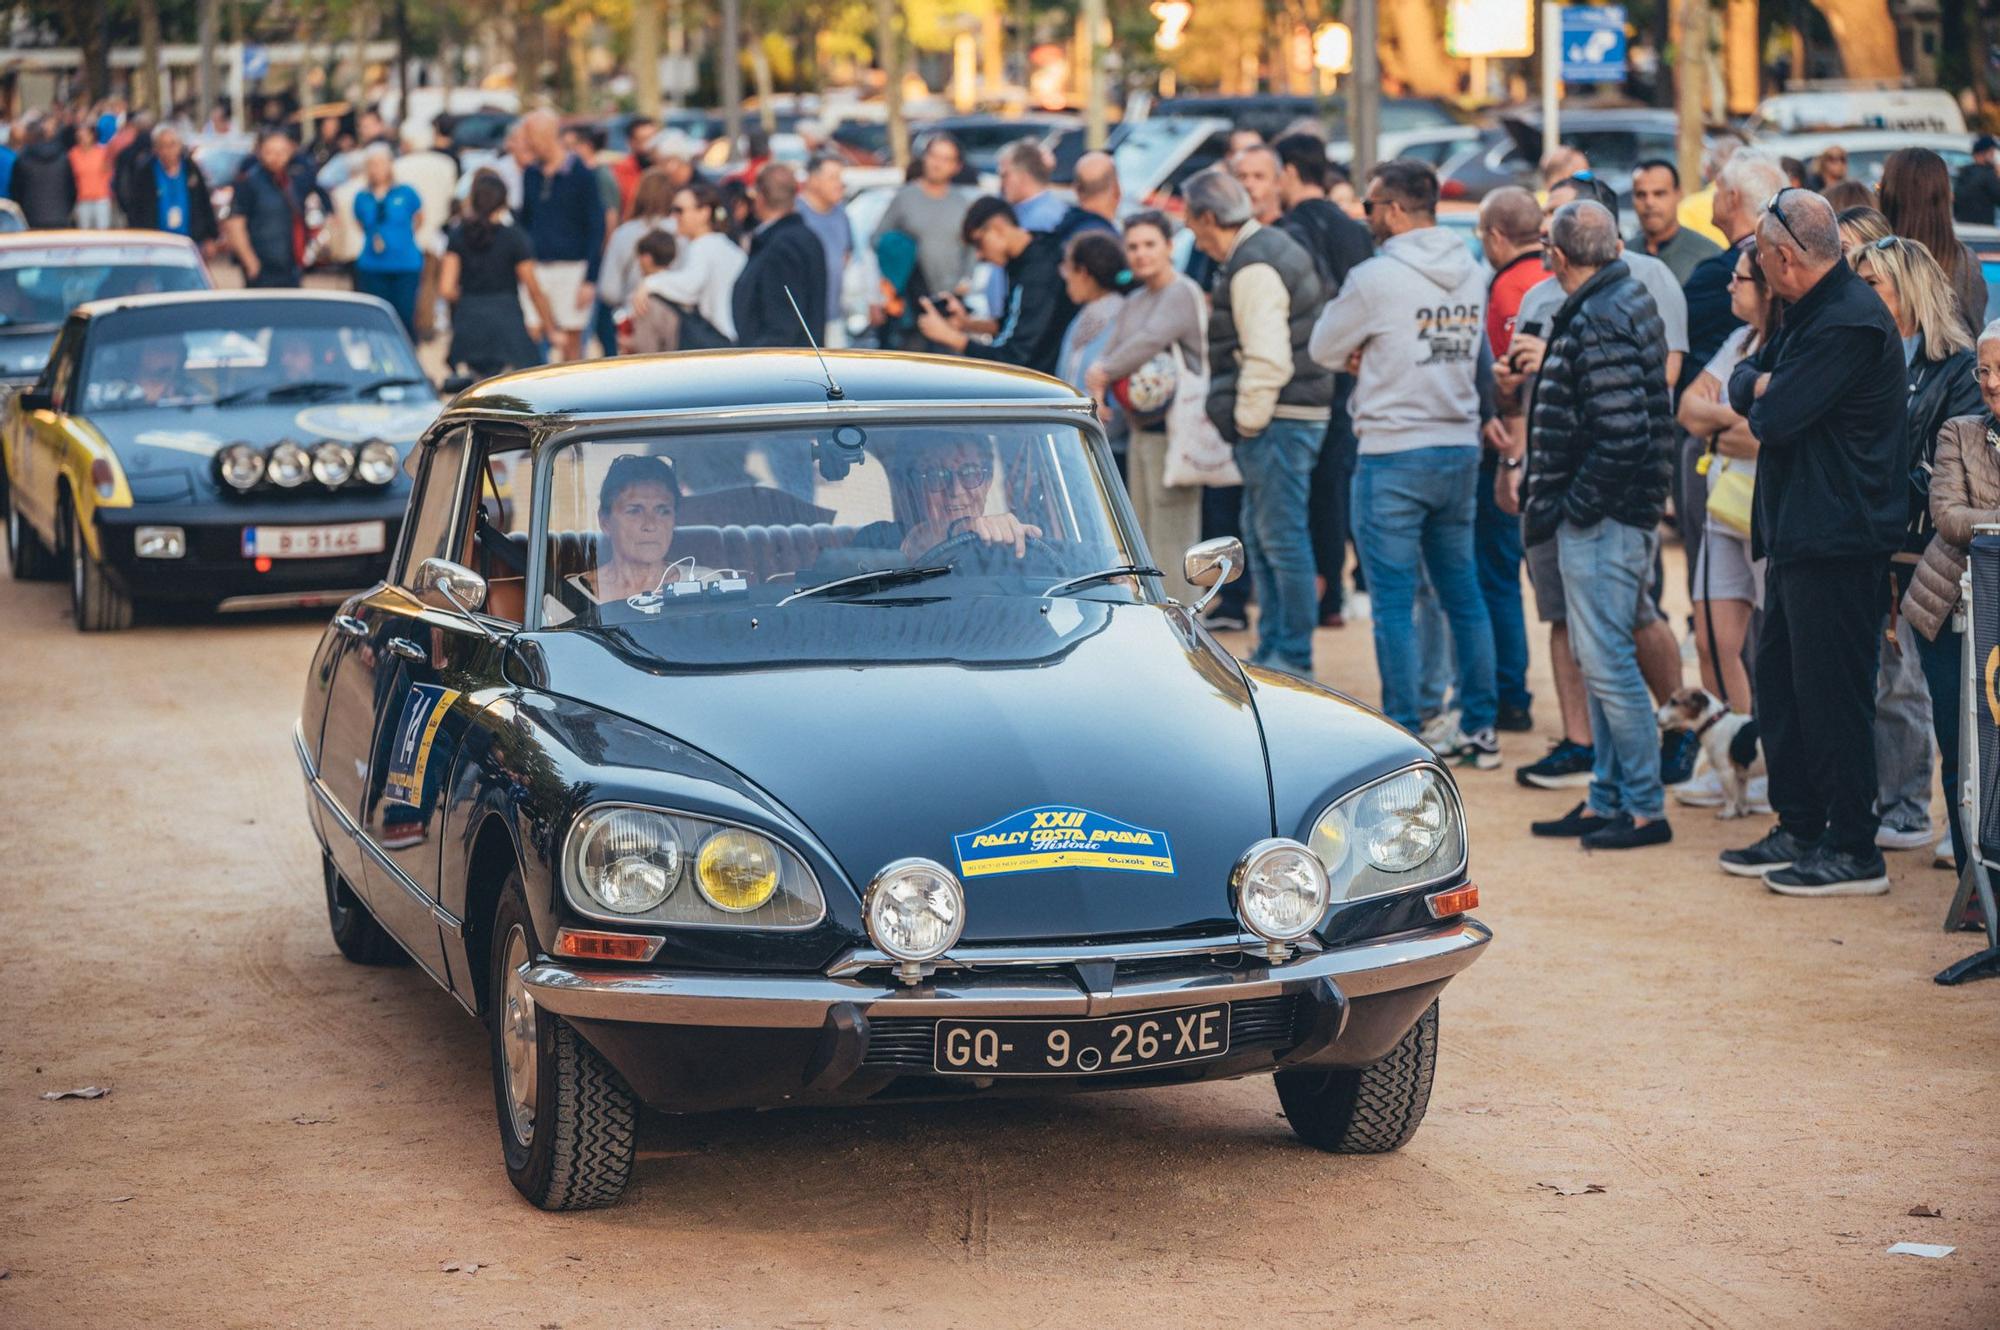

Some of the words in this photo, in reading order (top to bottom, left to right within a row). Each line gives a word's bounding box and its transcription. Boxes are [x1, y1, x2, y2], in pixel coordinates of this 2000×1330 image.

[1030, 812, 1087, 829] XXII
[971, 831, 1029, 848] RALLY
[1030, 828, 1088, 841] COSTA
[1089, 830, 1154, 846] BRAVA
[1110, 1010, 1221, 1063] 26-XE
